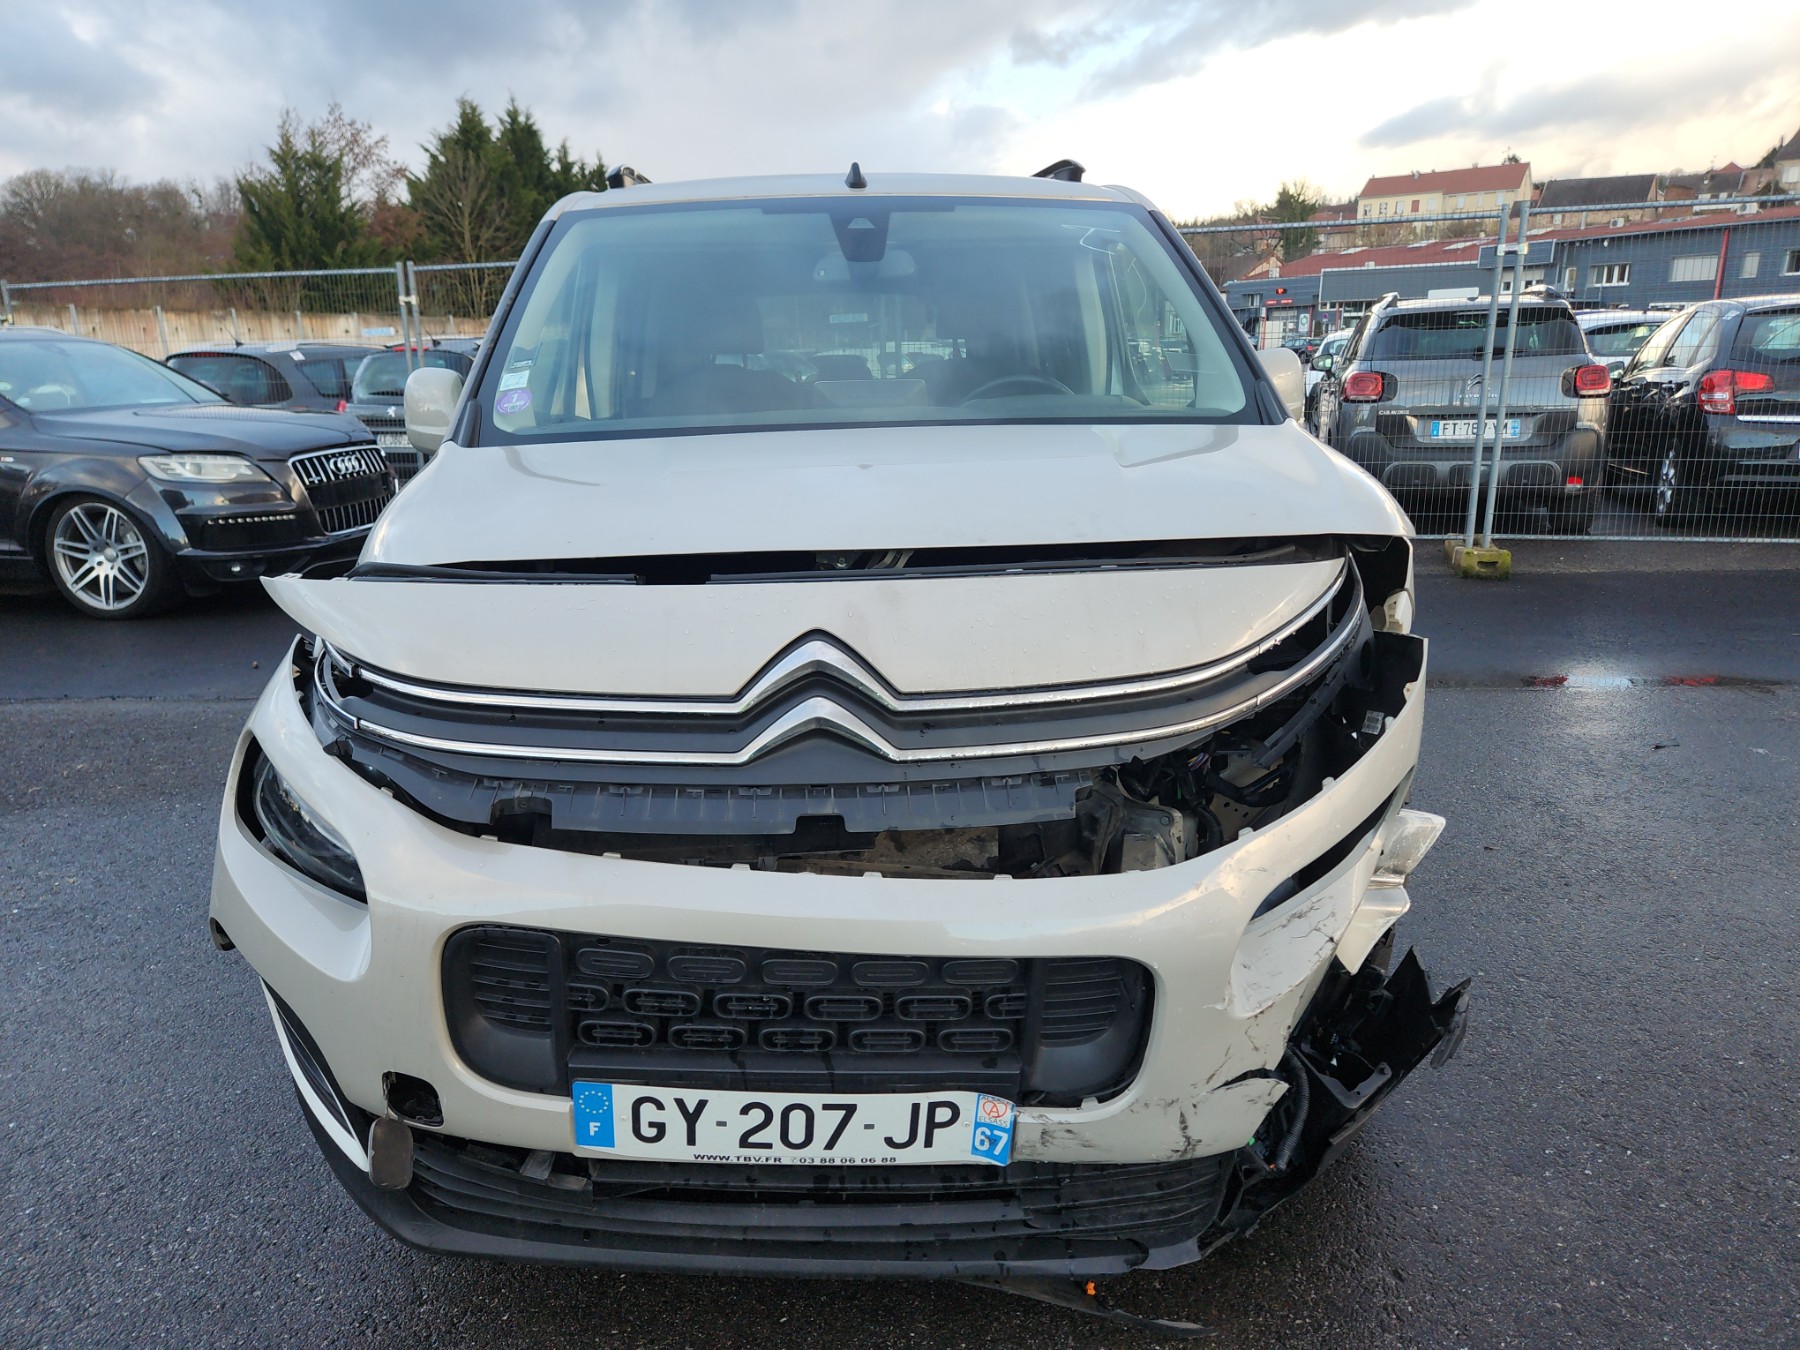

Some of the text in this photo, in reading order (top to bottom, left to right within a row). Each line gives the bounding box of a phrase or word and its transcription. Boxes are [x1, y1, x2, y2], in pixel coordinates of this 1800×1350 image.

[631, 1096, 961, 1150] GY-207-JP
[979, 1115, 1009, 1128] ELSASS
[589, 1122, 601, 1136] F
[974, 1127, 1009, 1156] 67
[693, 1153, 782, 1163] WWW.TBV.FR
